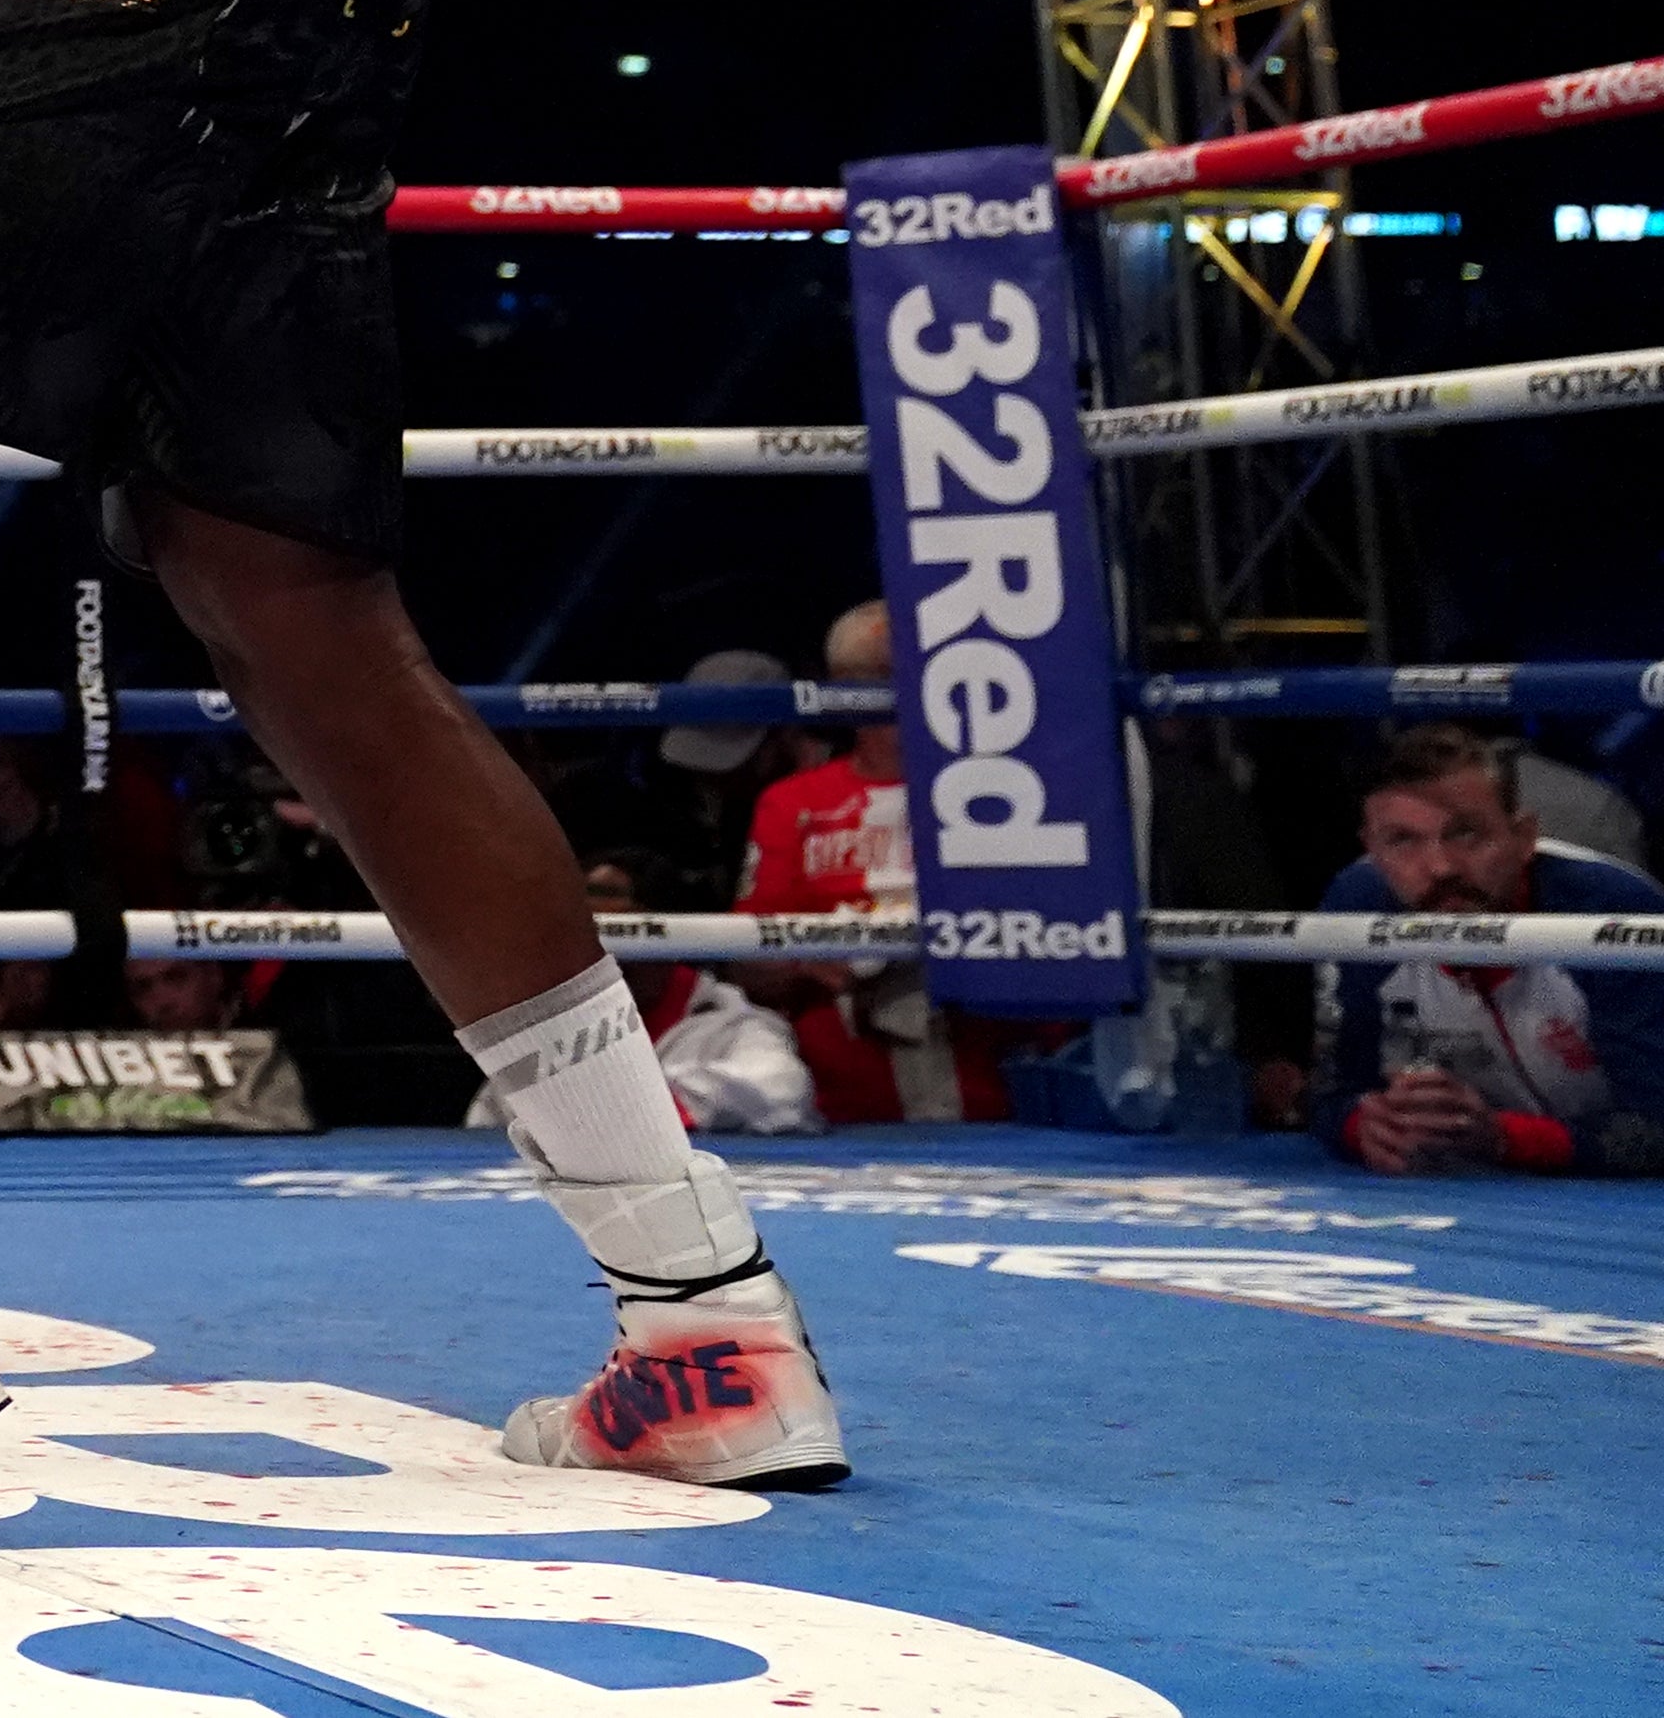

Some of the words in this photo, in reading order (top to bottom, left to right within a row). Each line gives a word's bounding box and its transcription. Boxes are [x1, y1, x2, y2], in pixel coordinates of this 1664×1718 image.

[856, 184, 1053, 248] 32Red
[886, 282, 1090, 870] 32Red
[206, 920, 341, 944] CoinField
[925, 911, 1126, 962] 32Red
[589, 1340, 754, 1452] UNITE
